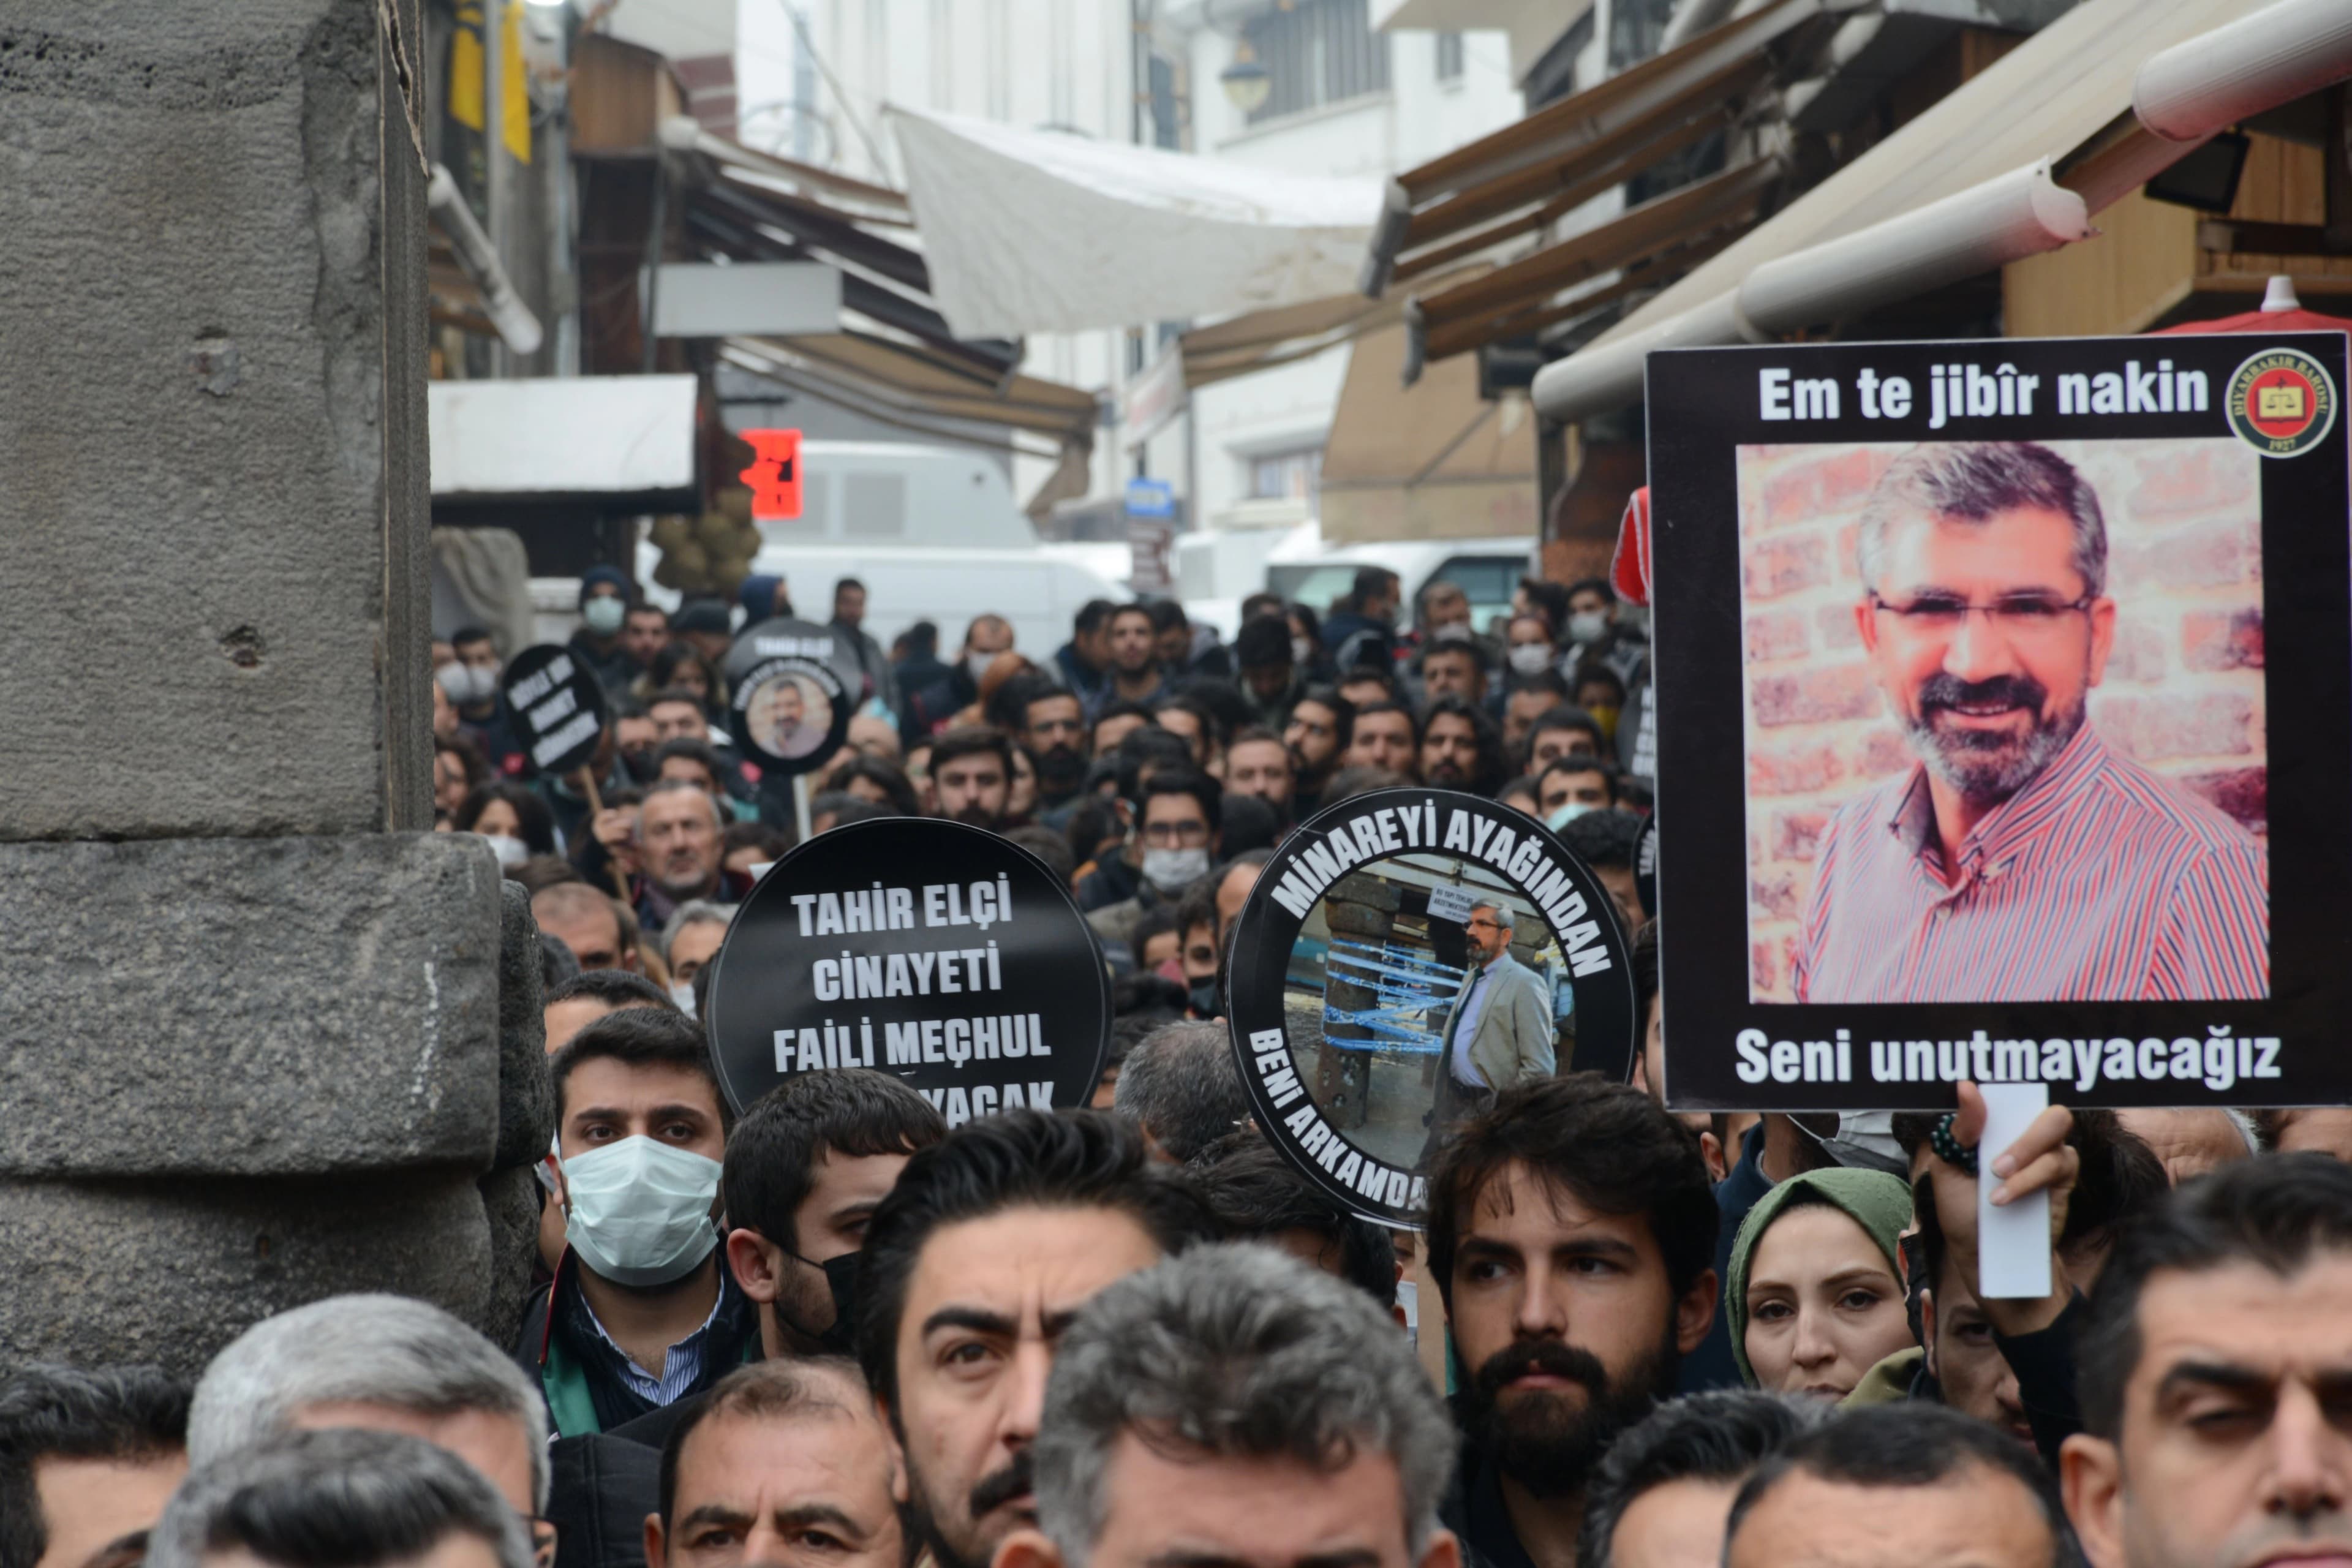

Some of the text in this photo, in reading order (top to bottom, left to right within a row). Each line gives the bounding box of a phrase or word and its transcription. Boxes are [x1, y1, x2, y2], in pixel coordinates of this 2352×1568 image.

[1759, 359, 2208, 429] Em te jibîr nakin
[2297, 361, 2328, 414] BAROSU
[2269, 439, 2296, 451] 1927
[790, 872, 1013, 937] TAHİR ELÇİ
[1270, 798, 1612, 978] MİNAREYİ AYAĞINDAN
[812, 940, 1003, 1002] CİNAYETİ
[773, 1012, 1052, 1073] FAİLİ MEÇHUL
[1736, 1025, 2282, 1092] Seni unutmayacağız
[918, 1081, 1055, 1131] YACAK
[1248, 1027, 1429, 1212] BENİ ARKAMDA
